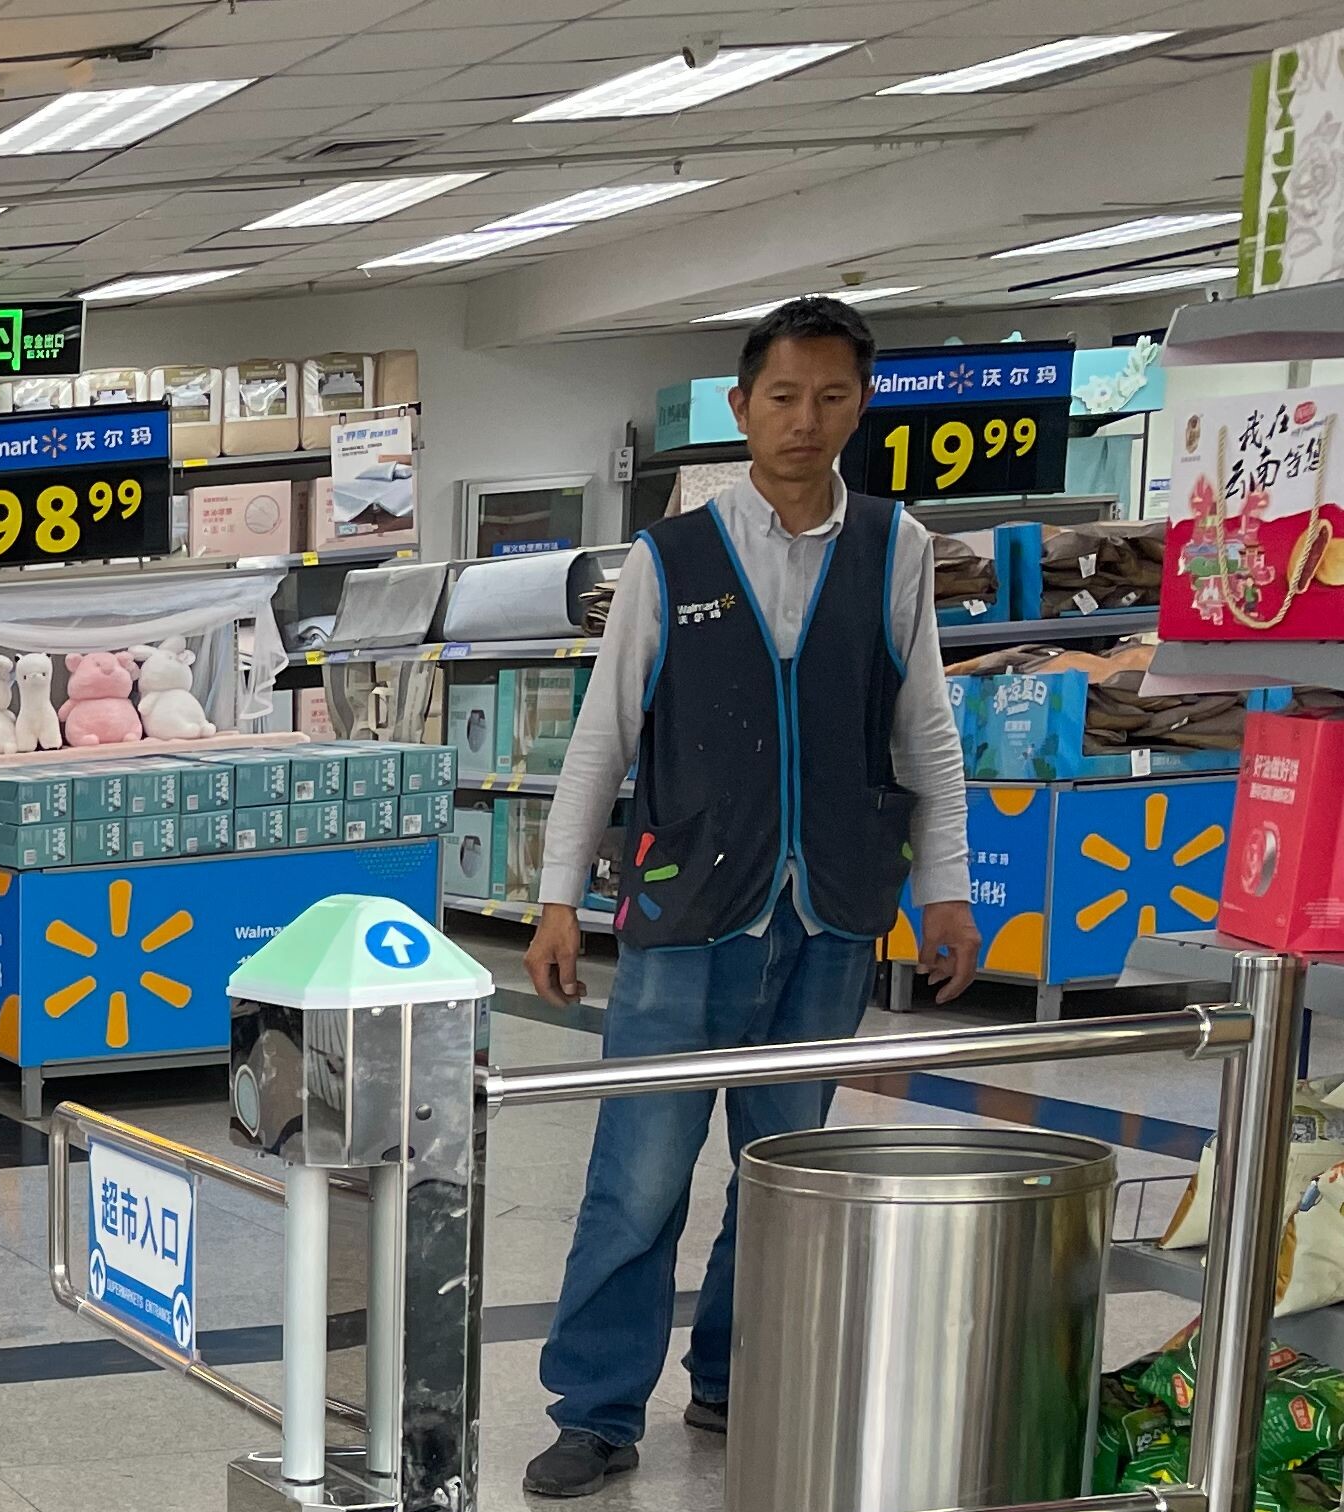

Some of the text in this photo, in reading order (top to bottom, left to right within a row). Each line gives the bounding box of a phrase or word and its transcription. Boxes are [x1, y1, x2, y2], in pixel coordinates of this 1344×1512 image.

[26, 349, 60, 359] EXIT
[981, 364, 1058, 387] 沃尔玛
[75, 426, 152, 451] 沃尔玛
[677, 600, 719, 614] Walmart
[101, 1177, 179, 1267] 超市入口
